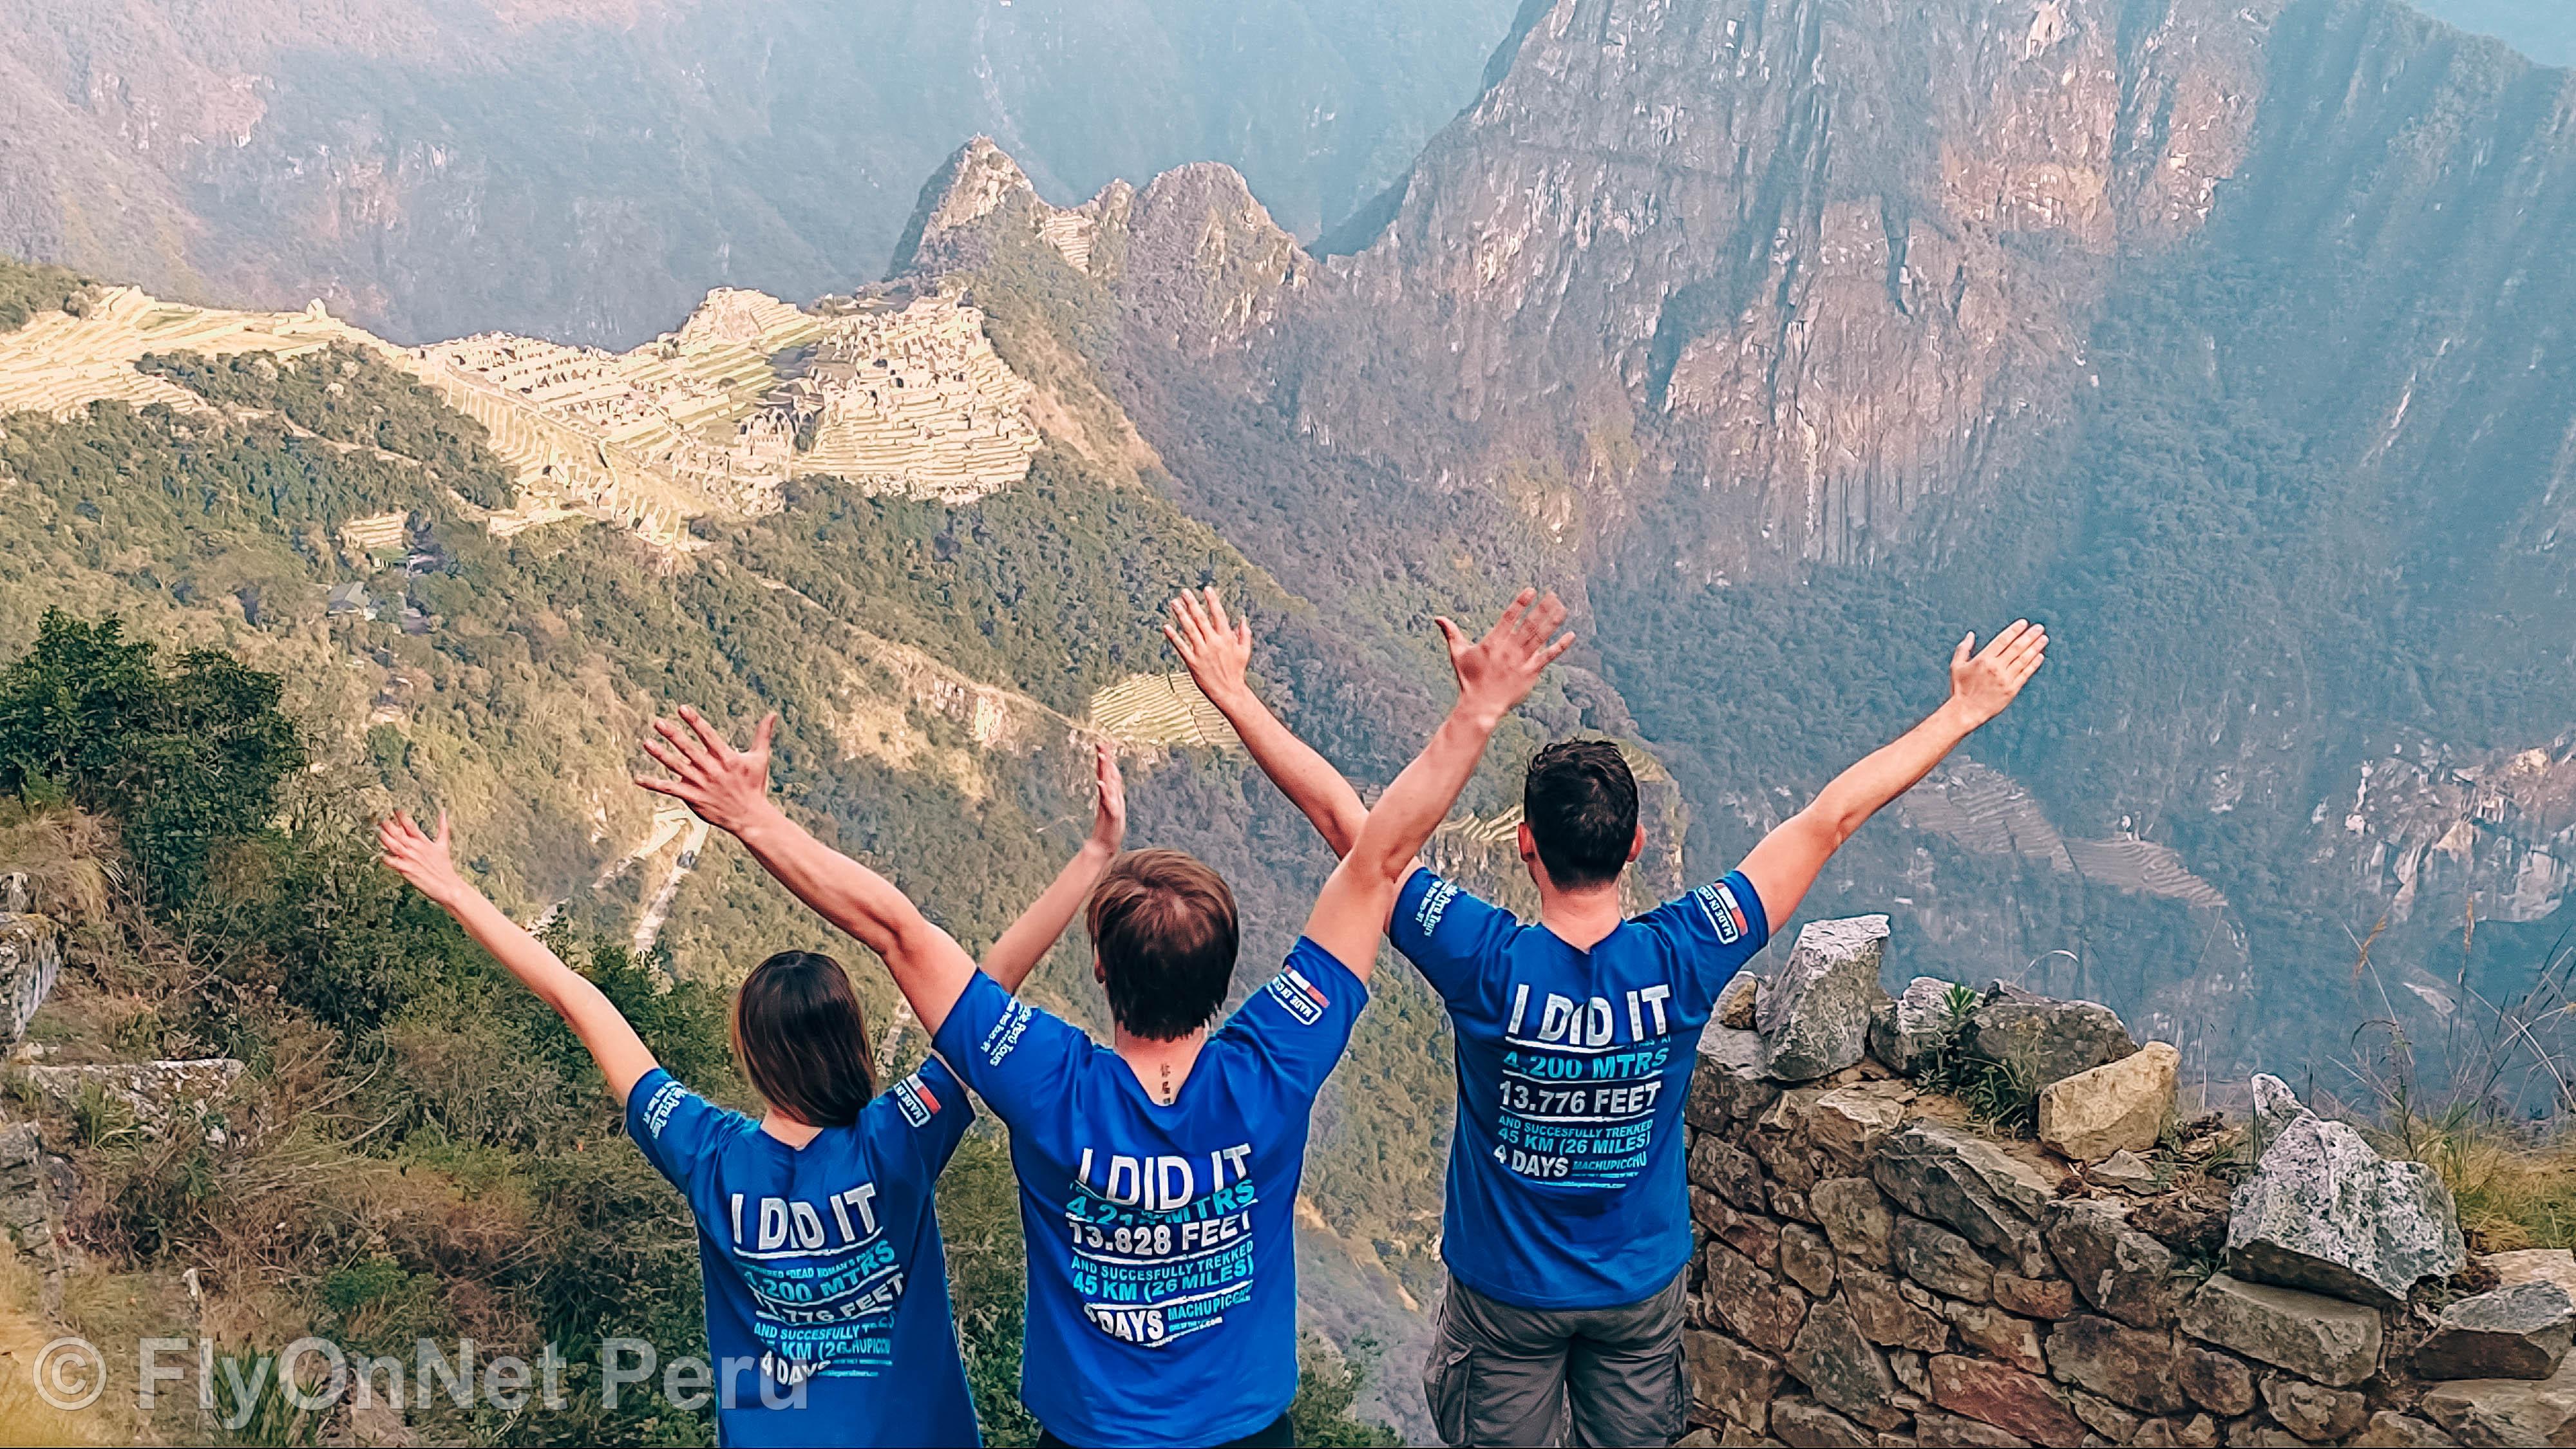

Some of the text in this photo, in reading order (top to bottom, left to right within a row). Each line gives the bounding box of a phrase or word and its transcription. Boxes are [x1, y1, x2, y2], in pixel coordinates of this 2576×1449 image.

[1715, 910, 1734, 936] MADE
[1508, 983, 1671, 1047] I DID IT
[990, 1043, 1014, 1066] Tours
[1504, 1048, 1670, 1079] 4.200 MTRS
[1499, 1080, 1662, 1114] 13.776 FEET
[1497, 1128, 1650, 1155] 45 KM (26 MILES)
[1499, 1115, 1654, 1138] AND SUCCESFULLY TREKKED
[1079, 1142, 1251, 1211] I DID IT
[1493, 1144, 1647, 1177] 4 DAYS MACHUPICCHU
[732, 1182, 876, 1250] I DD IT
[1066, 1196, 1155, 1226] 4.21
[1068, 1210, 1251, 1256] 13.828 FEET
[820, 1239, 895, 1297] MTRS
[1071, 1240, 1253, 1281] AND SUCCESFULLY TREKKED
[839, 1272, 904, 1318] FEET
[1073, 1255, 1254, 1303] 45 KM (26 MILES)
[754, 1323, 778, 1338] AND
[780, 1325, 860, 1340] SUCCESFULLY
[1097, 1310, 1164, 1342] DAYS
[782, 1341, 811, 1360] KM
